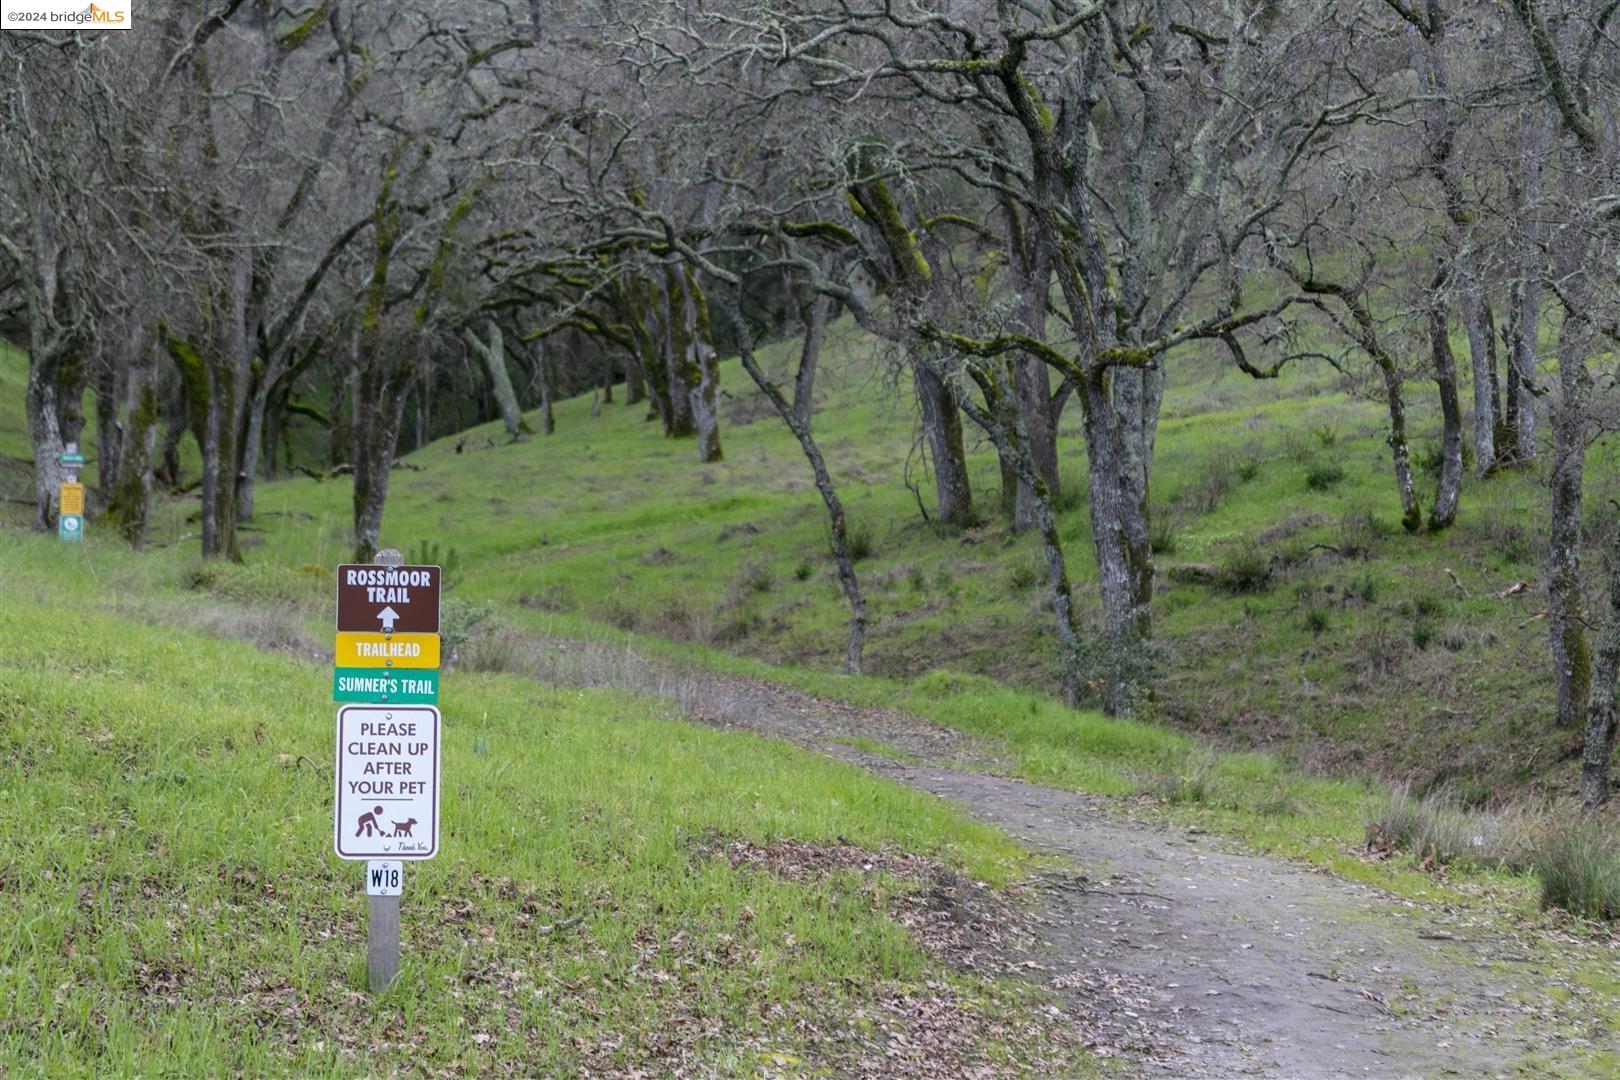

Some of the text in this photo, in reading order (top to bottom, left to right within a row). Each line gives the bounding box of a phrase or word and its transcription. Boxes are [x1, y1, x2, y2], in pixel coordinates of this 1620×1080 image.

[347, 570, 430, 587] ROSSMOOR
[367, 587, 410, 603] TRAIL
[356, 642, 420, 657] TRAILHEAD
[338, 676, 434, 695] SUMNER'S TRAIL
[360, 723, 416, 736] PLEASE
[347, 742, 429, 756] CLEAN UP
[363, 762, 412, 775] AFTER
[348, 781, 426, 795] YOUR PET
[397, 842, 415, 851] Thank
[371, 869, 399, 888] W18
